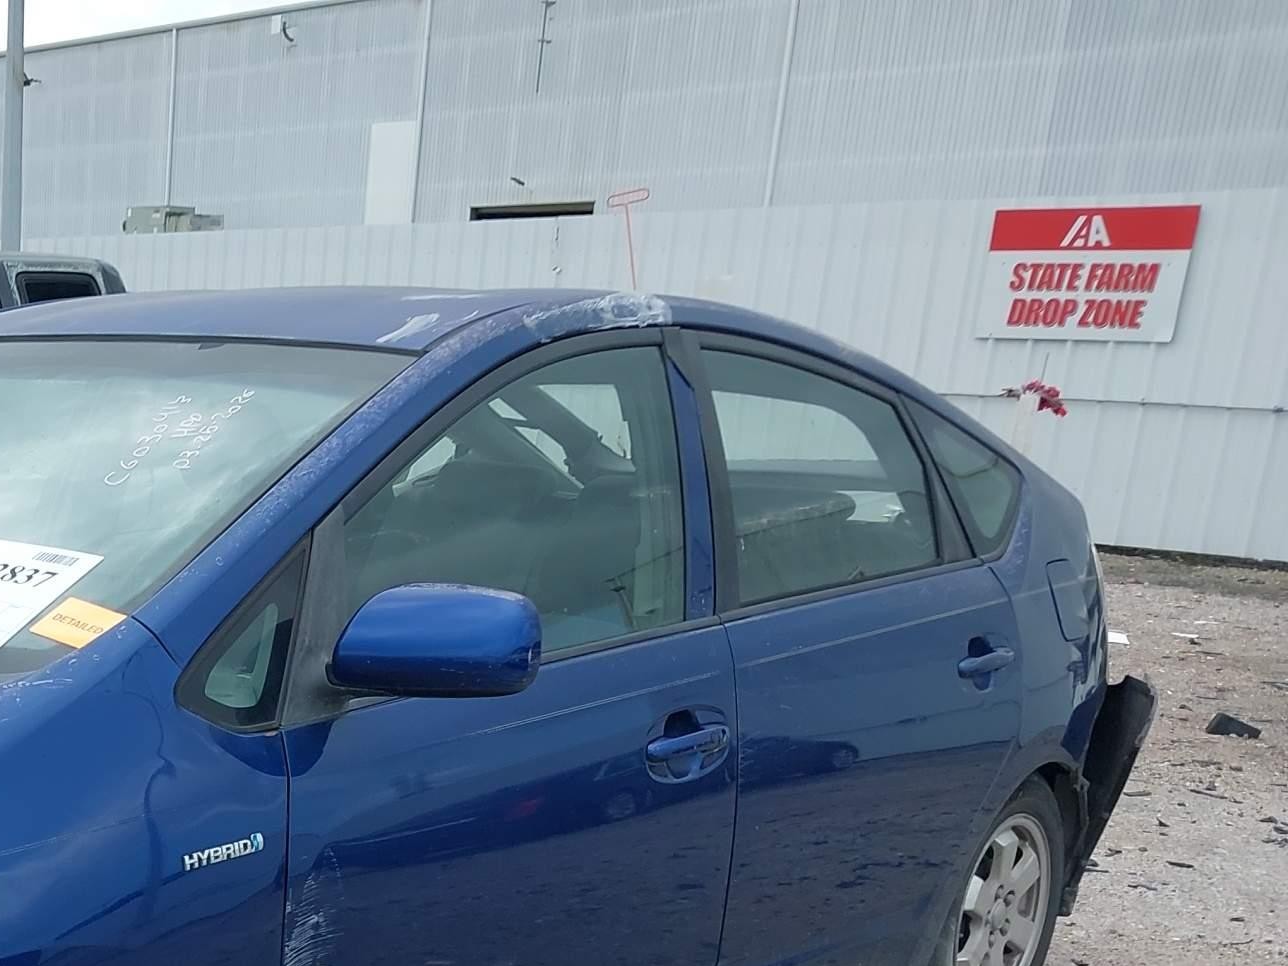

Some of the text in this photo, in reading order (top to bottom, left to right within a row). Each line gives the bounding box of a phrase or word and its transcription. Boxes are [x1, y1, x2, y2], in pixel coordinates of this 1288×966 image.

[1009, 262, 1161, 293] STATE FARM
[1006, 298, 1147, 330] DROP ZONE
[51, 612, 104, 634] DETAILED
[183, 839, 253, 871] HYBRID
